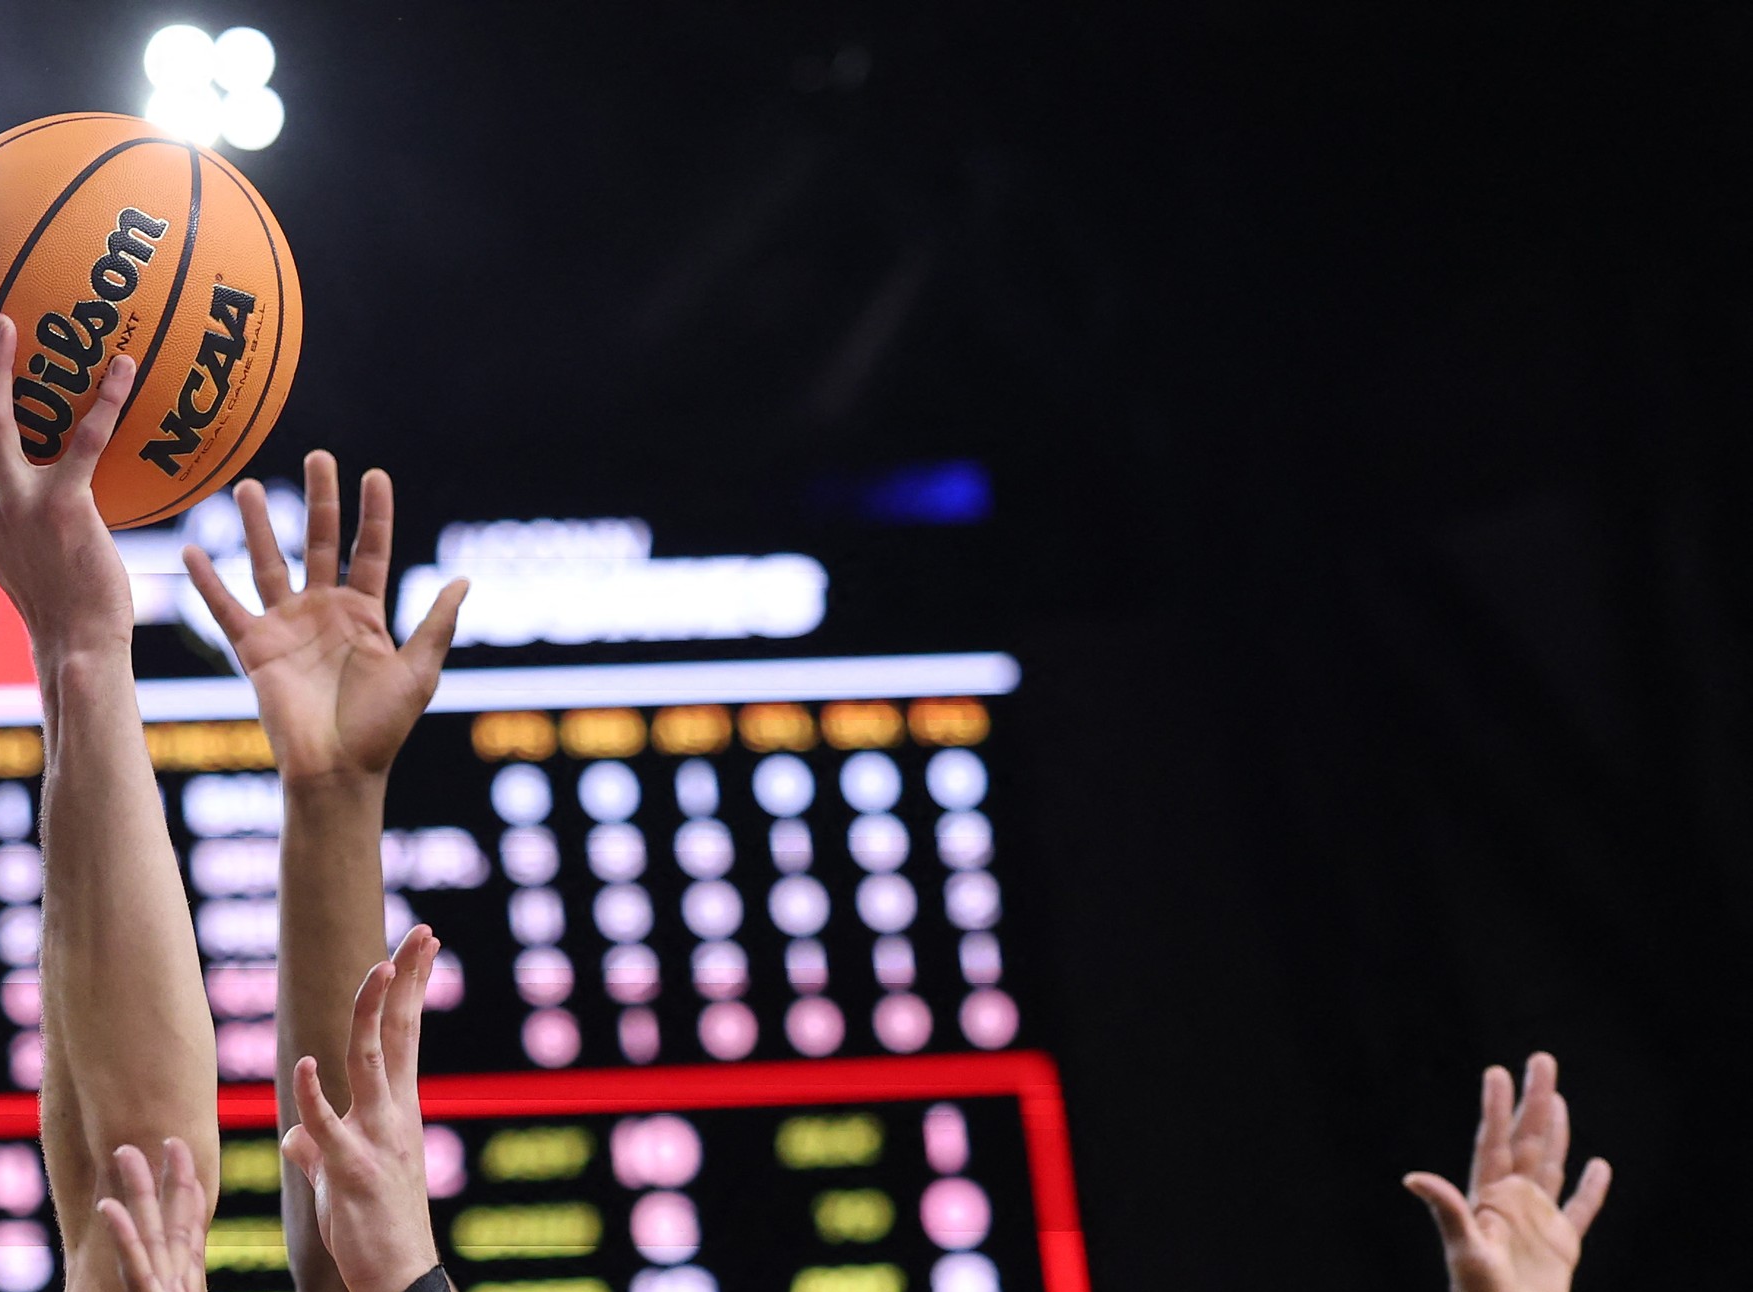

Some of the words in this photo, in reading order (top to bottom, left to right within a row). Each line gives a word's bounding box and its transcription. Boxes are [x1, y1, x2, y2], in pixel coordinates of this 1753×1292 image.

[13, 206, 169, 459] Wilson
[116, 312, 141, 351] NXT
[138, 283, 257, 478] NCAA
[227, 357, 254, 412] GAME
[250, 303, 267, 353] BALL
